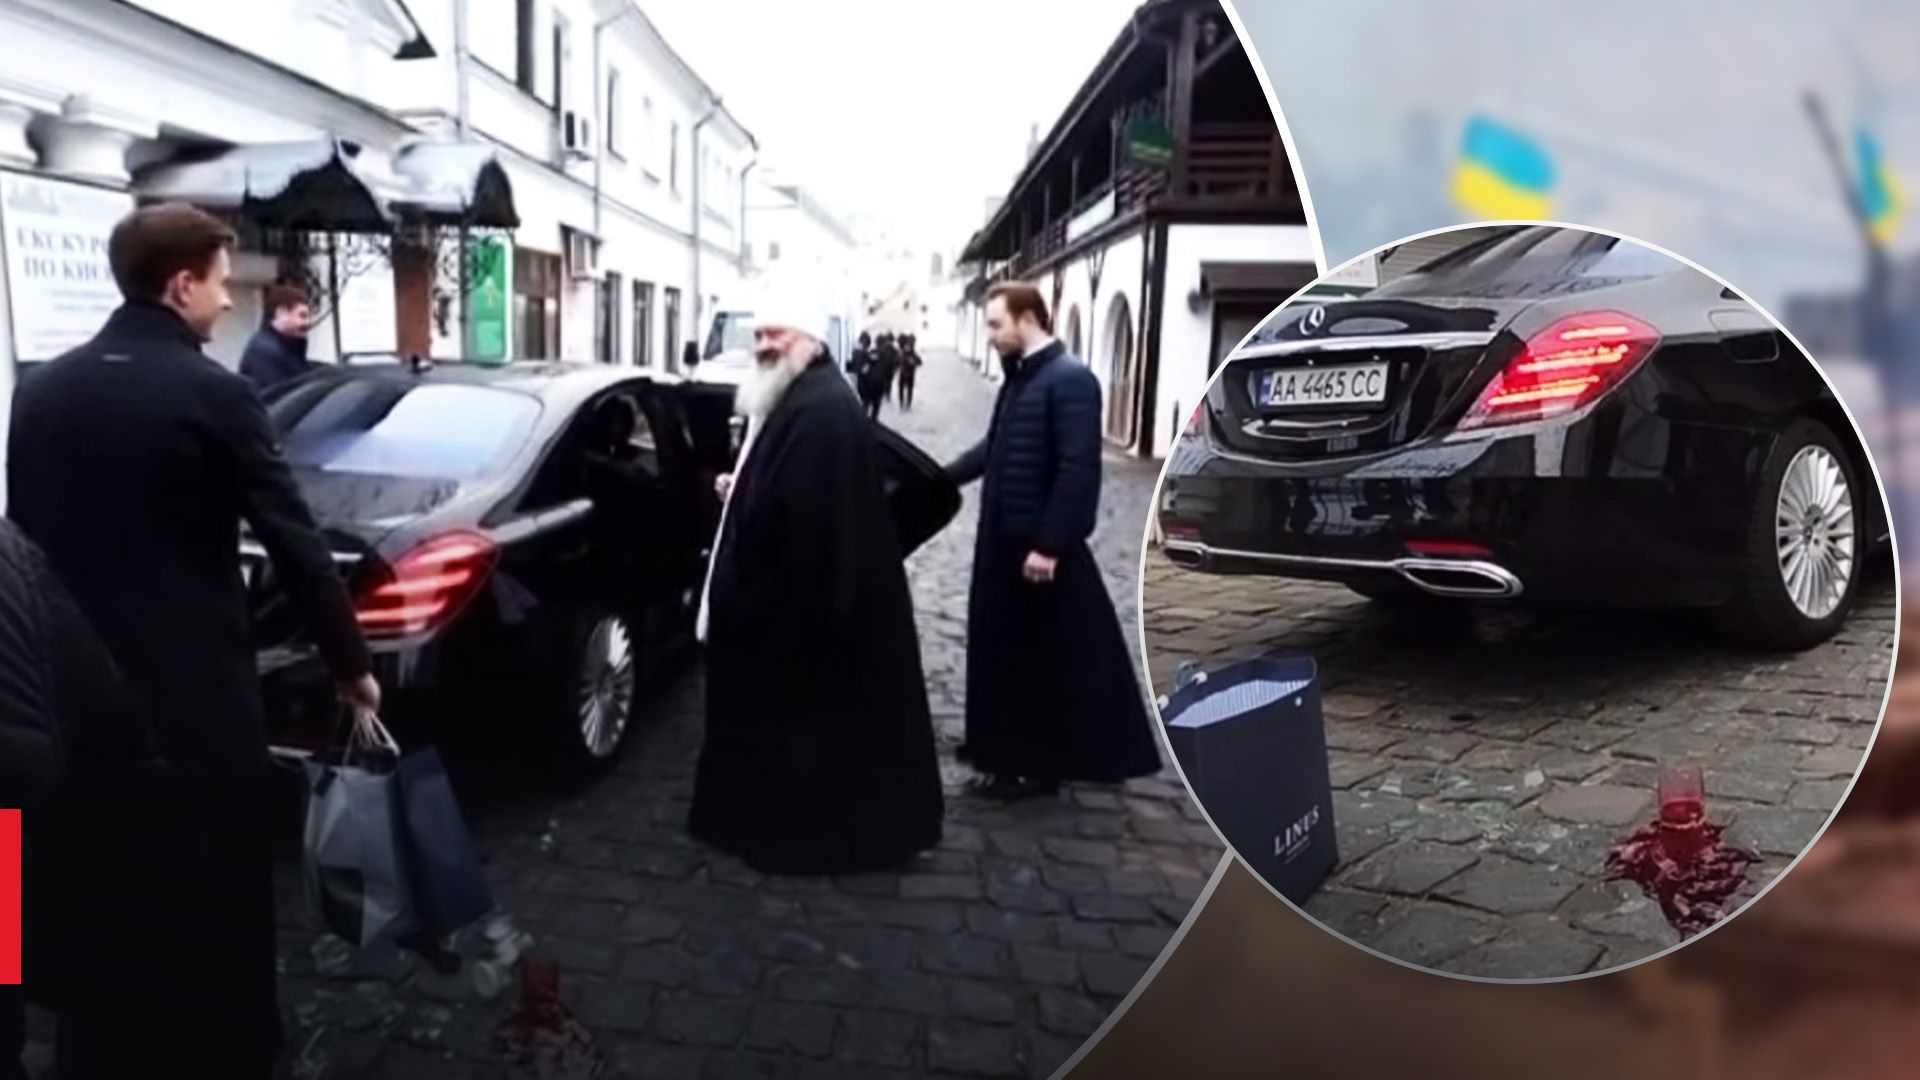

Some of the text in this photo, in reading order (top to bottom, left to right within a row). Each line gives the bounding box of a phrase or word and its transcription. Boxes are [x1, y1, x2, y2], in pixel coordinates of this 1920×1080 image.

[24, 257, 56, 279] ПО
[1272, 369, 1381, 401] AA 4465 CC
[1274, 804, 1319, 857] LINUS
